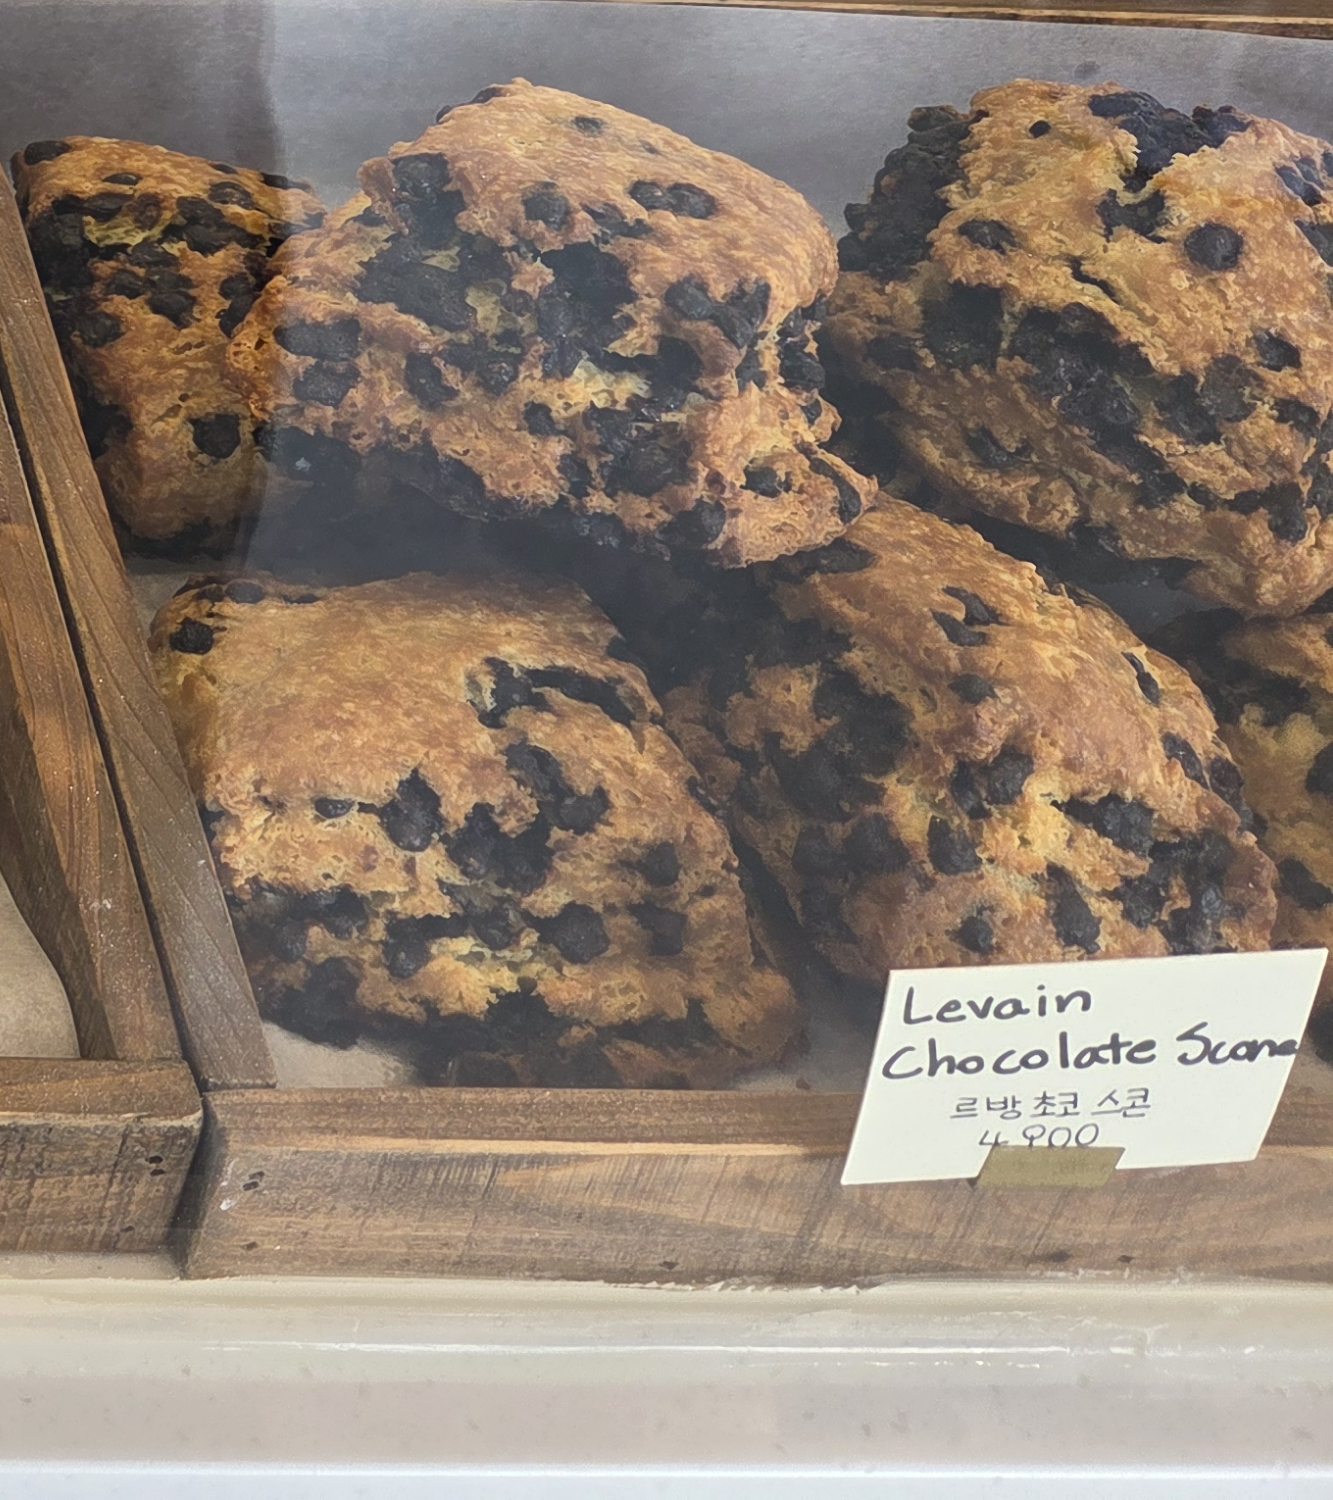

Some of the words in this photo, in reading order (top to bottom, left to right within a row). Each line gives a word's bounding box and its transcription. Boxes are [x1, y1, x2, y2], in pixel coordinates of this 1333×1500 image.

[903, 984, 1092, 1025] Levain
[881, 1030, 1157, 1080] Chocolate
[949, 1094, 1022, 1120] 르방
[1029, 1090, 1080, 1118] 초코
[1090, 1087, 1151, 1119] 스콘
